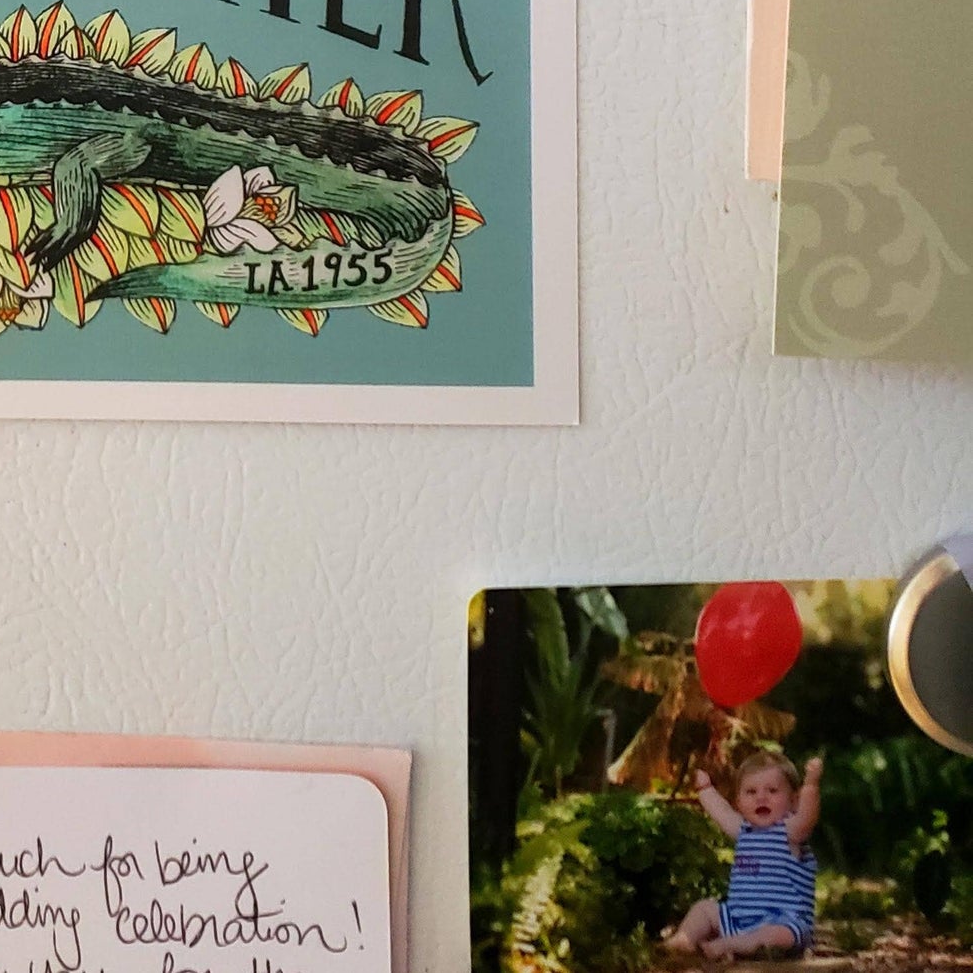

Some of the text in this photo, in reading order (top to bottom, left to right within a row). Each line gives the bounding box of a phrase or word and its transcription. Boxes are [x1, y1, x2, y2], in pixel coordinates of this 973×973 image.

[243, 248, 393, 295] LA 1955
[90, 835, 144, 917] for
[155, 836, 270, 920] being
[115, 897, 365, 954] celebration!
